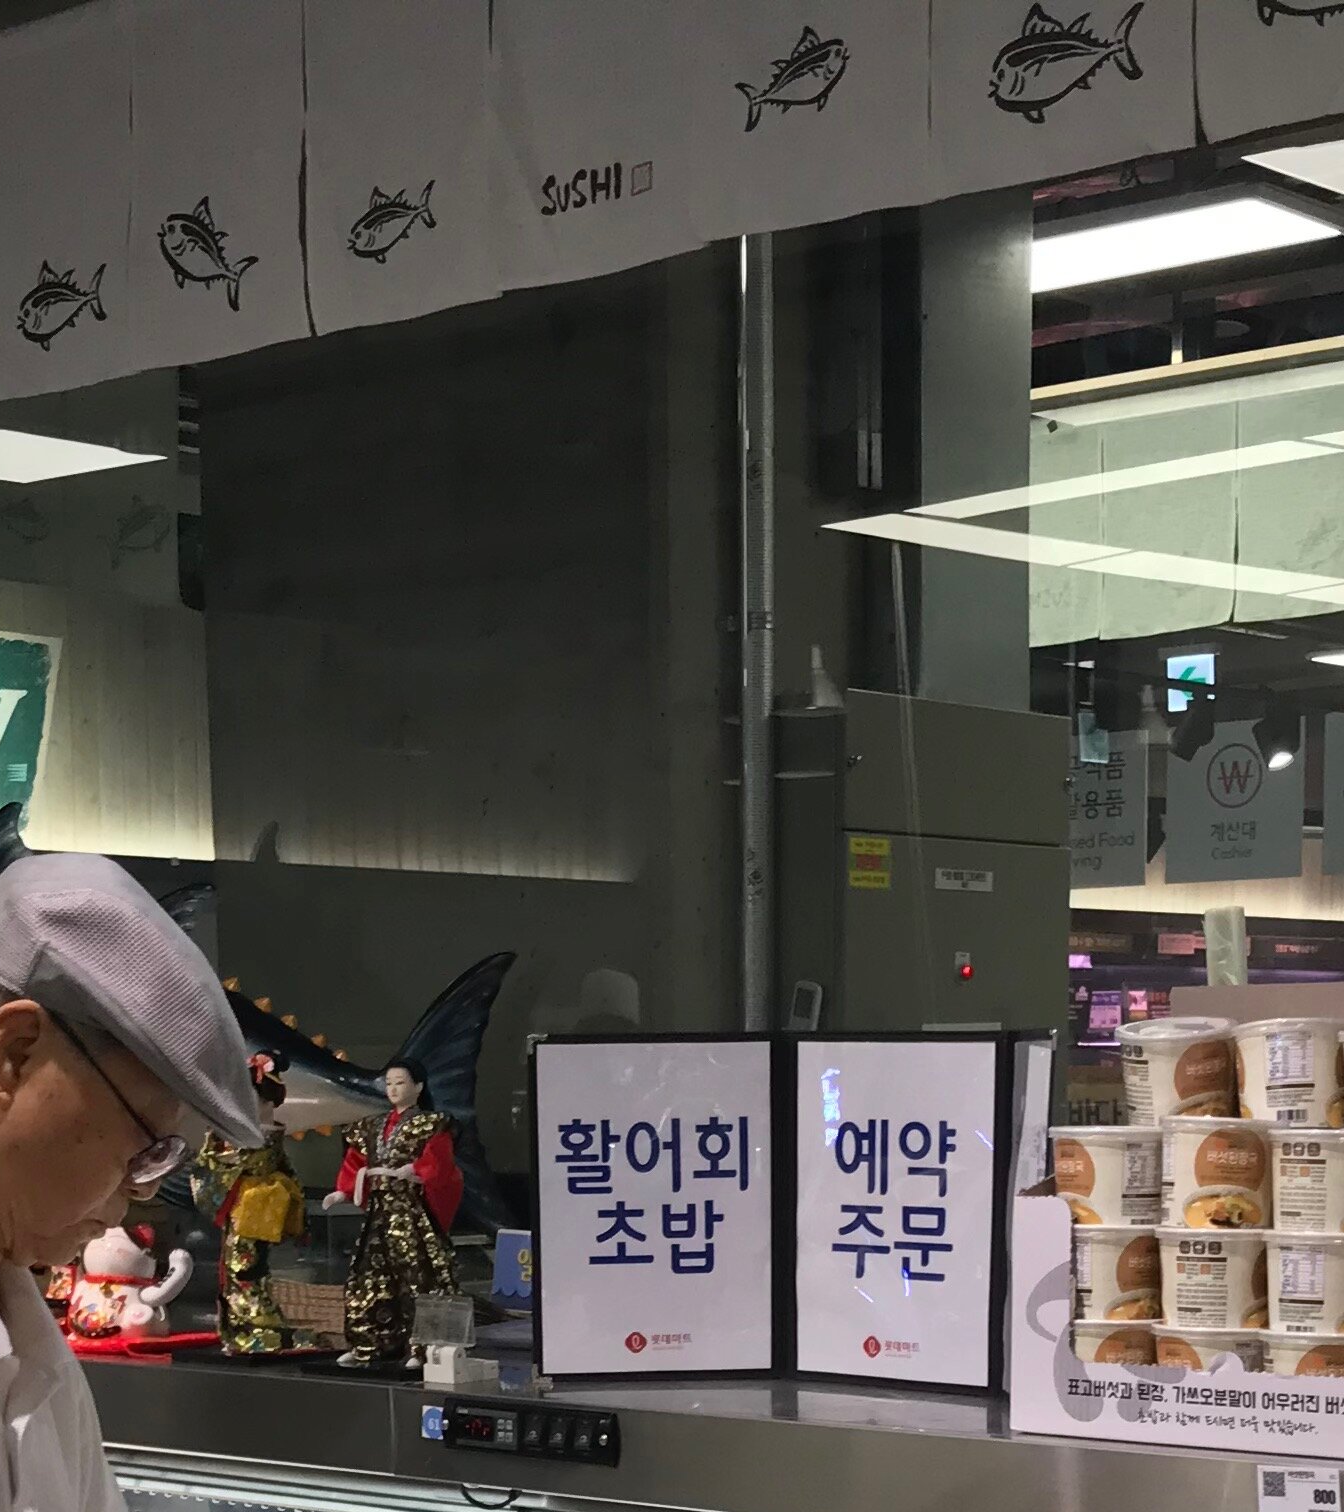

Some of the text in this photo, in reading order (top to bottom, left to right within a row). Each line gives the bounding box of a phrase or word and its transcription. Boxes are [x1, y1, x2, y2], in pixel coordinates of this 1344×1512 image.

[542, 161, 623, 215] SUSHI
[554, 1116, 750, 1195] 활어회
[834, 1119, 957, 1198] 예약
[588, 1199, 725, 1274] 초밥
[831, 1204, 954, 1282] 주문
[1067, 1378, 1134, 1401] 표고버섯과
[1261, 1389, 1321, 1415] 어우러진
